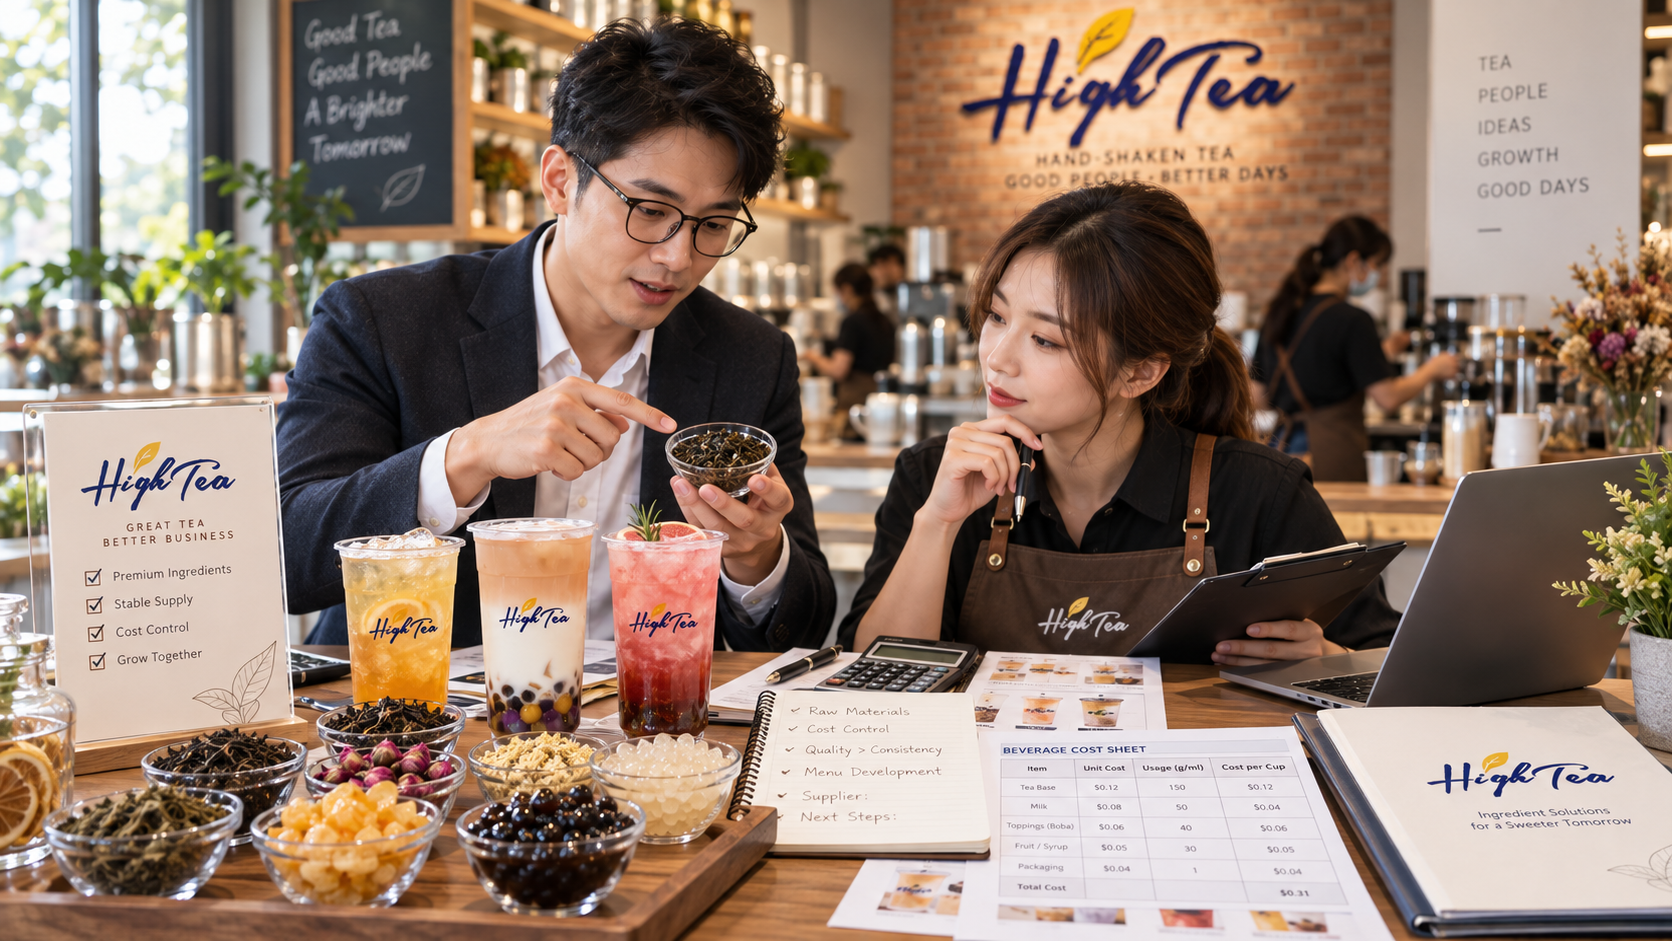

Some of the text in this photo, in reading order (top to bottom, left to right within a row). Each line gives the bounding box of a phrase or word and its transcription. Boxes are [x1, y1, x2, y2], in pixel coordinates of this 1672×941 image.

[304, 9, 402, 52] Good Tea
[307, 41, 434, 91] Good People
[1479, 54, 1512, 72] TEA
[961, 37, 1295, 147] High Tea
[1478, 82, 1548, 103] PEOPLE
[303, 89, 410, 132] A Brighter
[1478, 116, 1532, 135] IDEAS
[308, 131, 412, 164] Tomorrow
[1198, 146, 1235, 162] TEA
[1478, 147, 1559, 167] GROWTH
[1004, 173, 1061, 190] GOOD
[1161, 168, 1229, 184] BETTER
[1239, 164, 1289, 181] DAYS
[1477, 177, 1590, 199] GOOD DAYS
[81, 457, 236, 511] High Tea
[126, 519, 205, 532] GREAT TEA
[103, 530, 234, 547] BETTER BUSINESS
[113, 565, 232, 582] Premium Ingredients
[114, 594, 194, 610] Stable Supply
[499, 606, 570, 633] High Tea
[629, 611, 698, 638] High Tea
[1038, 608, 1129, 641] High Tea
[116, 622, 189, 638] Cost Control
[369, 617, 438, 644] High Tea
[117, 650, 202, 665] Grow Together
[809, 707, 910, 716] Raw Materials
[807, 725, 889, 733] Cost Control
[805, 745, 852, 758] Quality
[870, 745, 943, 756] Consistency
[1003, 745, 1146, 754] BEVERAGE COST SHEET
[805, 766, 942, 779] Menu Development
[1142, 764, 1204, 773] Usage (g/ml)
[1264, 764, 1286, 772] Cup
[1427, 762, 1614, 797] High Tea
[802, 791, 868, 804] Supplier:
[1097, 803, 1122, 811] $0.08
[1254, 803, 1281, 811] $0.04
[1478, 807, 1610, 820] Ingredient Solutions
[801, 811, 897, 824] Next Steps:
[1471, 822, 1489, 830] for
[1506, 820, 1559, 829] Sweeter
[1563, 817, 1632, 826] Tomorrow
[1006, 822, 1075, 831] Toppings (Boba)
[1261, 824, 1288, 832] $0.06
[1101, 844, 1128, 852] $0.05
[1185, 845, 1197, 853] 30
[1267, 846, 1295, 854] $0.05
[1018, 863, 1064, 872] Packaging
[1104, 865, 1131, 873] $0.04
[1274, 867, 1303, 876] $0.04
